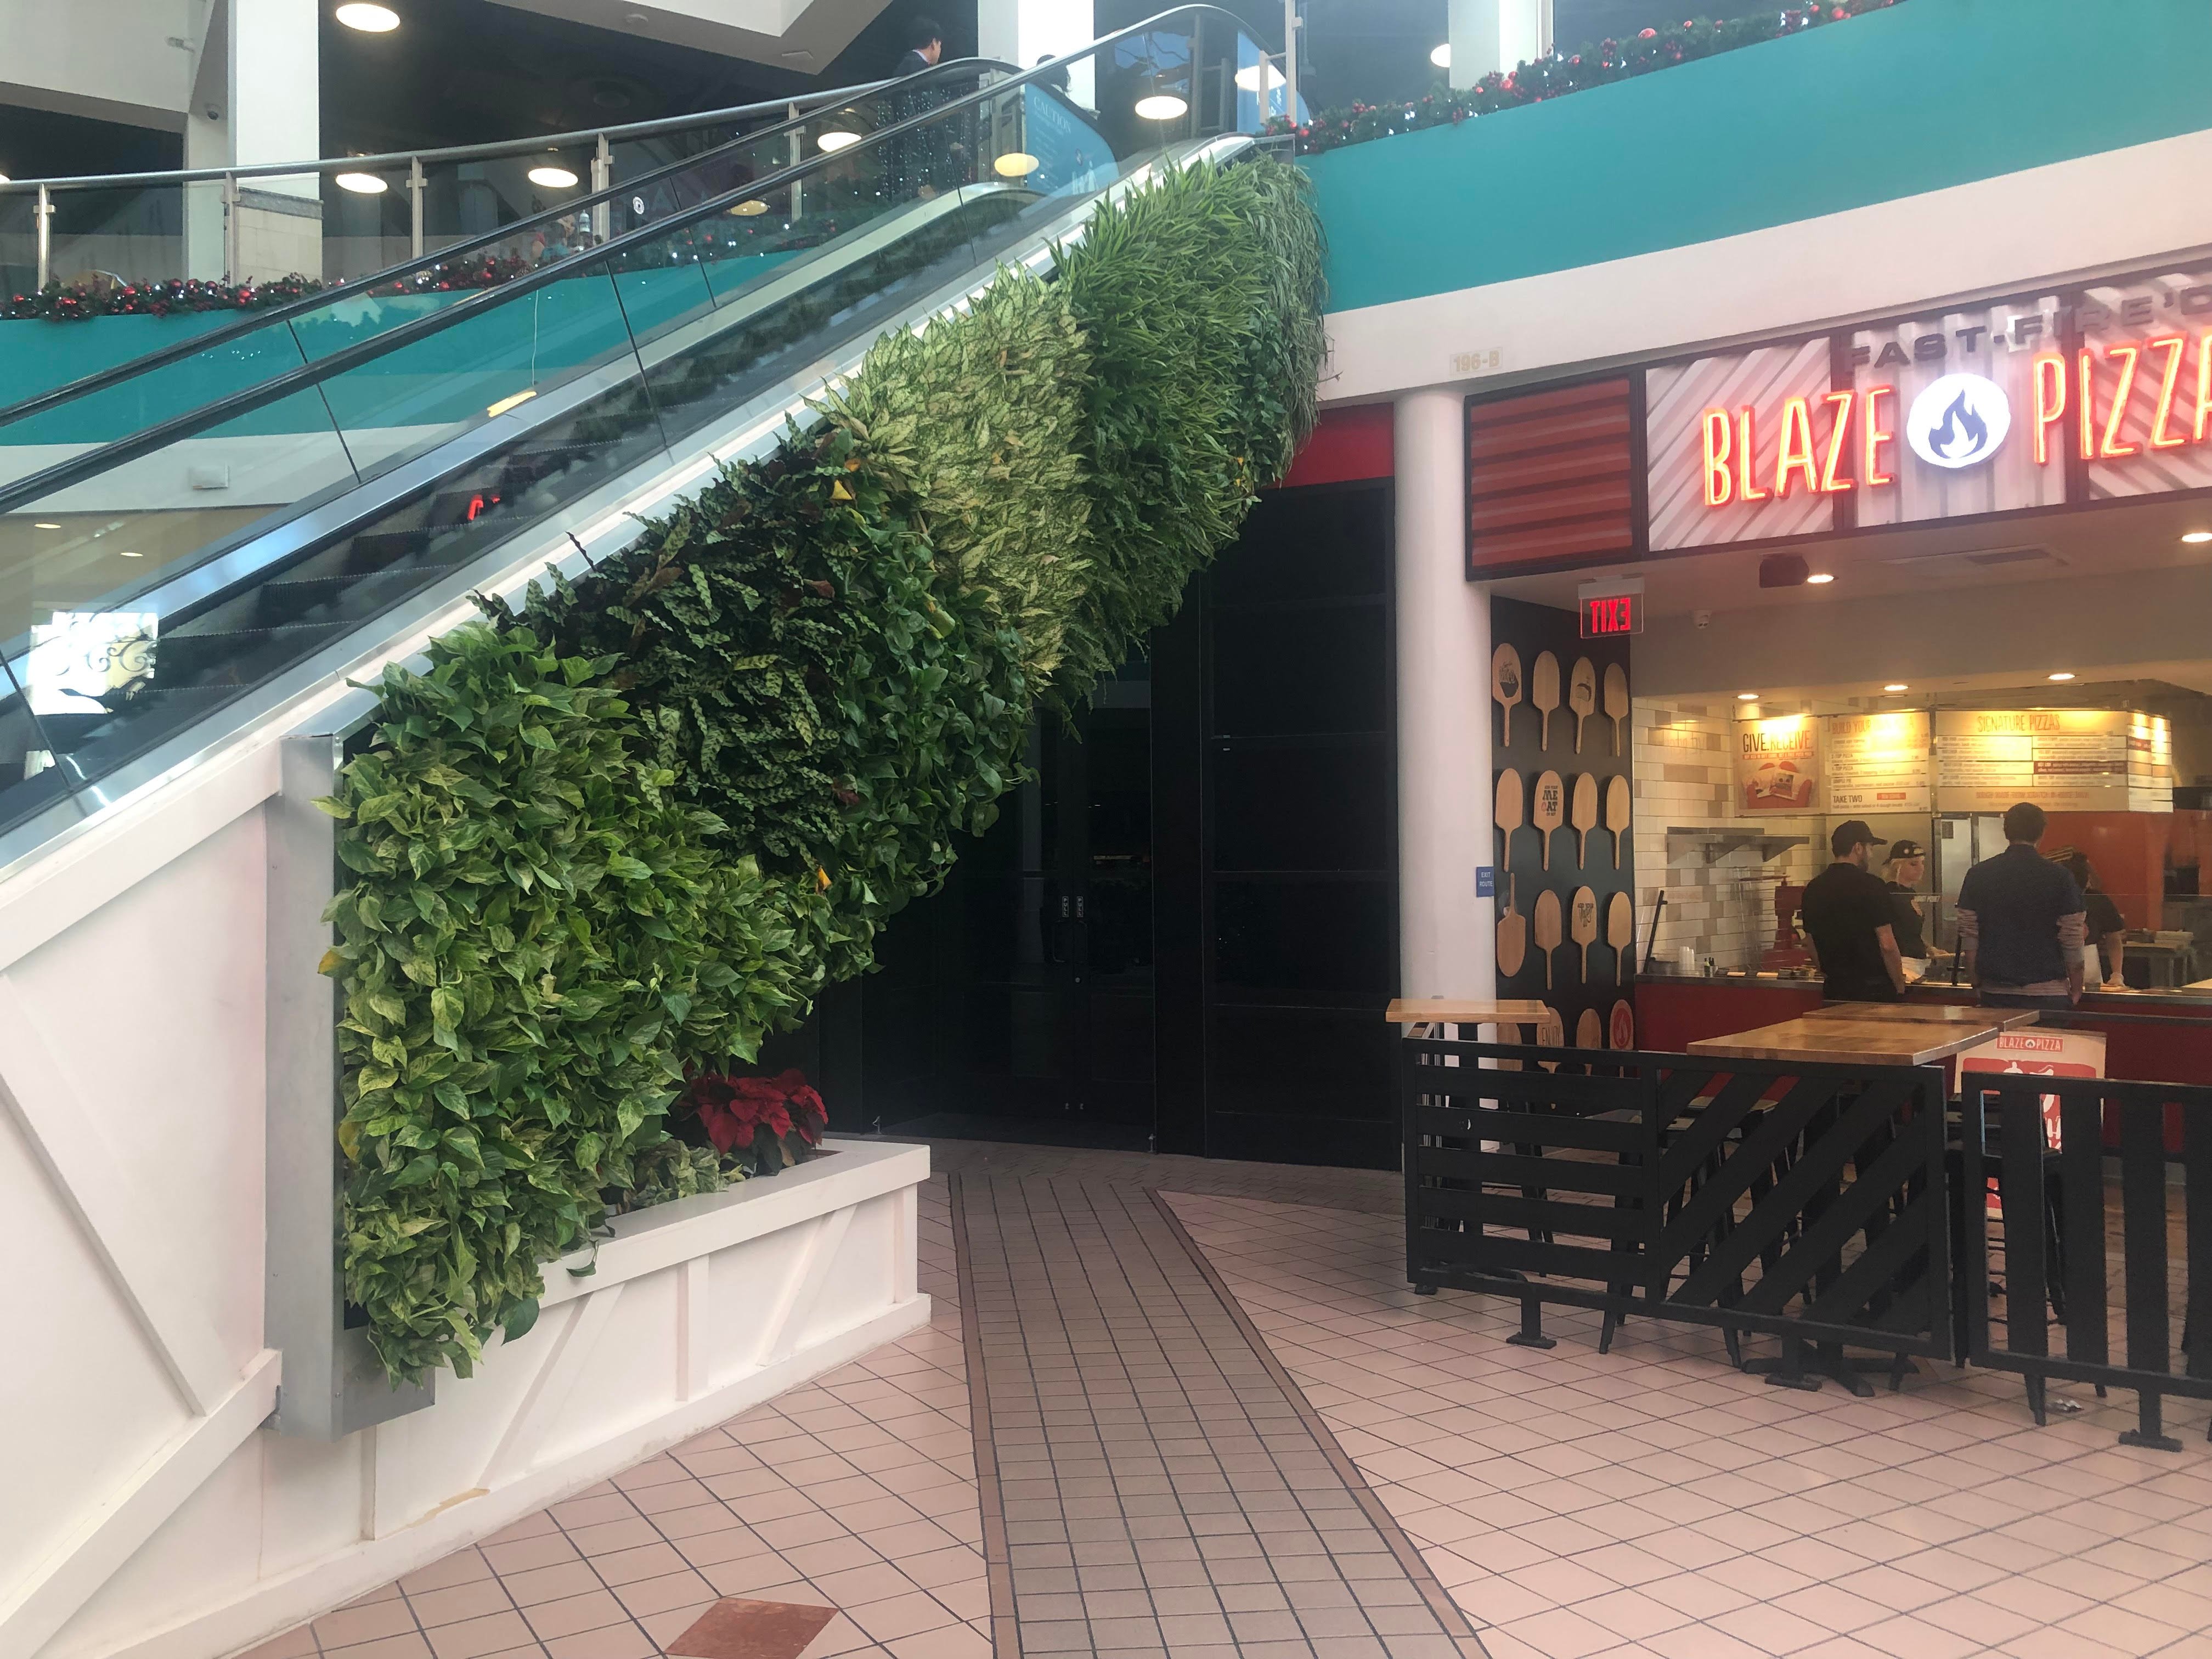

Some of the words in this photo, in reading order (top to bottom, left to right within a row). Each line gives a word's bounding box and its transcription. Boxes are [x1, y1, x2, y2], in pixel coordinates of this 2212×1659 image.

[1034, 96, 1071, 134] CAUTION
[1453, 350, 1500, 372] 196-B
[1703, 383, 1897, 507] BLAZE
[1978, 715, 2025, 732] SIGNATURE
[2029, 714, 2060, 731] PIZZAS
[1543, 790, 1558, 800] ME
[1833, 795, 1847, 803] TAKE
[1849, 794, 1863, 803] TWO
[1999, 1036, 2024, 1049] BLAZE
[2036, 1037, 2061, 1051] PIZZA
